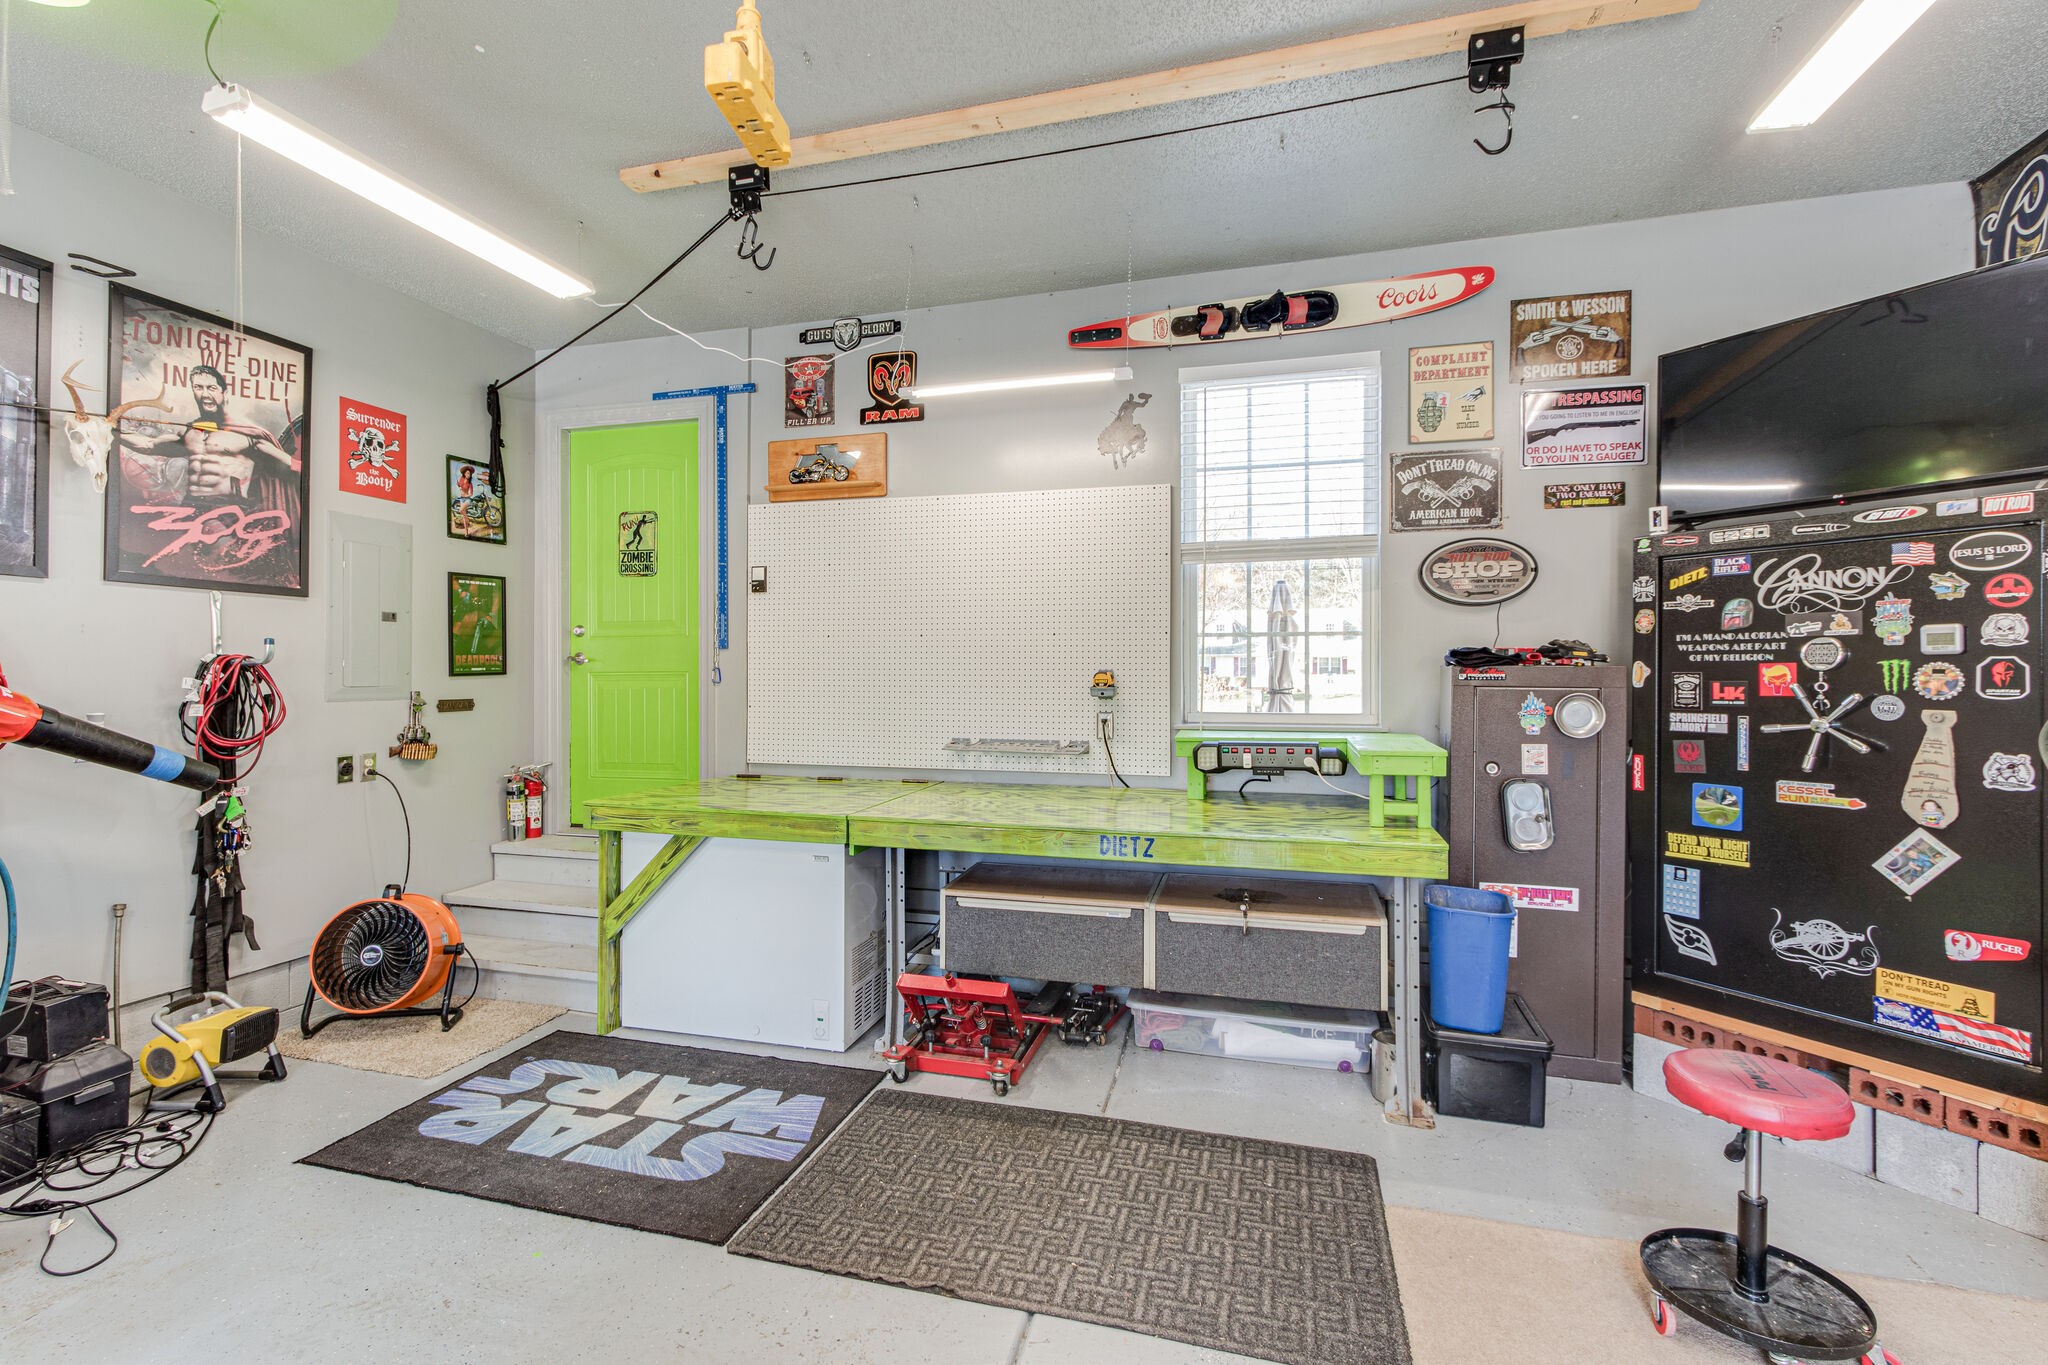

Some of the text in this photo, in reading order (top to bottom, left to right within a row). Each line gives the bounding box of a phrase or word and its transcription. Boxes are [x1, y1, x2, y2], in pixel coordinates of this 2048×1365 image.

[1377, 283, 1439, 309] Coors
[1517, 296, 1626, 321] SMITH & WESSON
[129, 317, 247, 357] TONIGHT
[807, 329, 832, 341] GUTS
[201, 349, 298, 384] WE DINE
[1416, 351, 1488, 367] COMPLAINT
[1413, 366, 1490, 382] DEPARTMENT
[1523, 360, 1617, 379] SPOKEN HERE
[163, 362, 289, 402] IN HELL!
[1440, 396, 1448, 407] 1
[1551, 389, 1643, 407] TRESPASSING
[346, 407, 401, 433] Surrender
[787, 416, 831, 426] FILL'ER UP
[865, 407, 920, 422] RAM
[1526, 446, 1540, 455] OR
[1542, 445, 1558, 454] DO
[1565, 443, 1593, 453] HAVE
[1593, 443, 1607, 452] TO
[1609, 441, 1642, 451] SPEAK
[1531, 451, 1637, 464] TO YOU IN 12 GAUGE?
[369, 468, 380, 476] the
[1427, 458, 1465, 473] TREAD
[1466, 459, 1482, 477] ON
[355, 471, 393, 492] Booty
[1547, 482, 1624, 493] GUNS ONLY HAVE
[1556, 491, 1576, 499] TWO
[1985, 496, 2006, 512] HOT
[1409, 507, 1483, 520] AMERICAN IRON
[130, 504, 291, 568] 300
[621, 551, 654, 563] ZOMBIE
[1448, 552, 1476, 562] HOT
[1953, 542, 2029, 559] JESUS IS LORD
[620, 563, 654, 573] CROSSING
[1432, 560, 1524, 579] SHOP
[1714, 556, 1747, 566] BLACK
[1669, 566, 1709, 590] DIETZ
[1714, 565, 1739, 575] RIFLE
[1753, 553, 1915, 615] CANNON
[1676, 631, 1789, 642] I'M A MANDALORIAN
[1677, 641, 1788, 652] WEAPONS ARE PART
[1688, 652, 1775, 662] OF MY RELIGION
[1712, 681, 1745, 700] HK
[1669, 712, 1729, 724] SPRINGFIELD
[1669, 722, 1707, 733] ARMORY
[1634, 757, 1642, 789] RUGER
[1778, 784, 1834, 797] KESSEL
[1778, 793, 1809, 804] RUN
[1099, 834, 1155, 860] DIETZ
[1667, 832, 1749, 852] DEFEND YOUR RIGHT
[1668, 842, 1749, 862] TO DEFEND YOURSELF
[1981, 939, 2024, 956] RUGER
[1881, 969, 1950, 992] DON'T TREAD
[1883, 979, 1948, 999] ON MY GUN RIGHTS
[1963, 1037, 2029, 1060] AMERICAN
[459, 1059, 826, 1142] WARS
[418, 1088, 810, 1182] STAR
